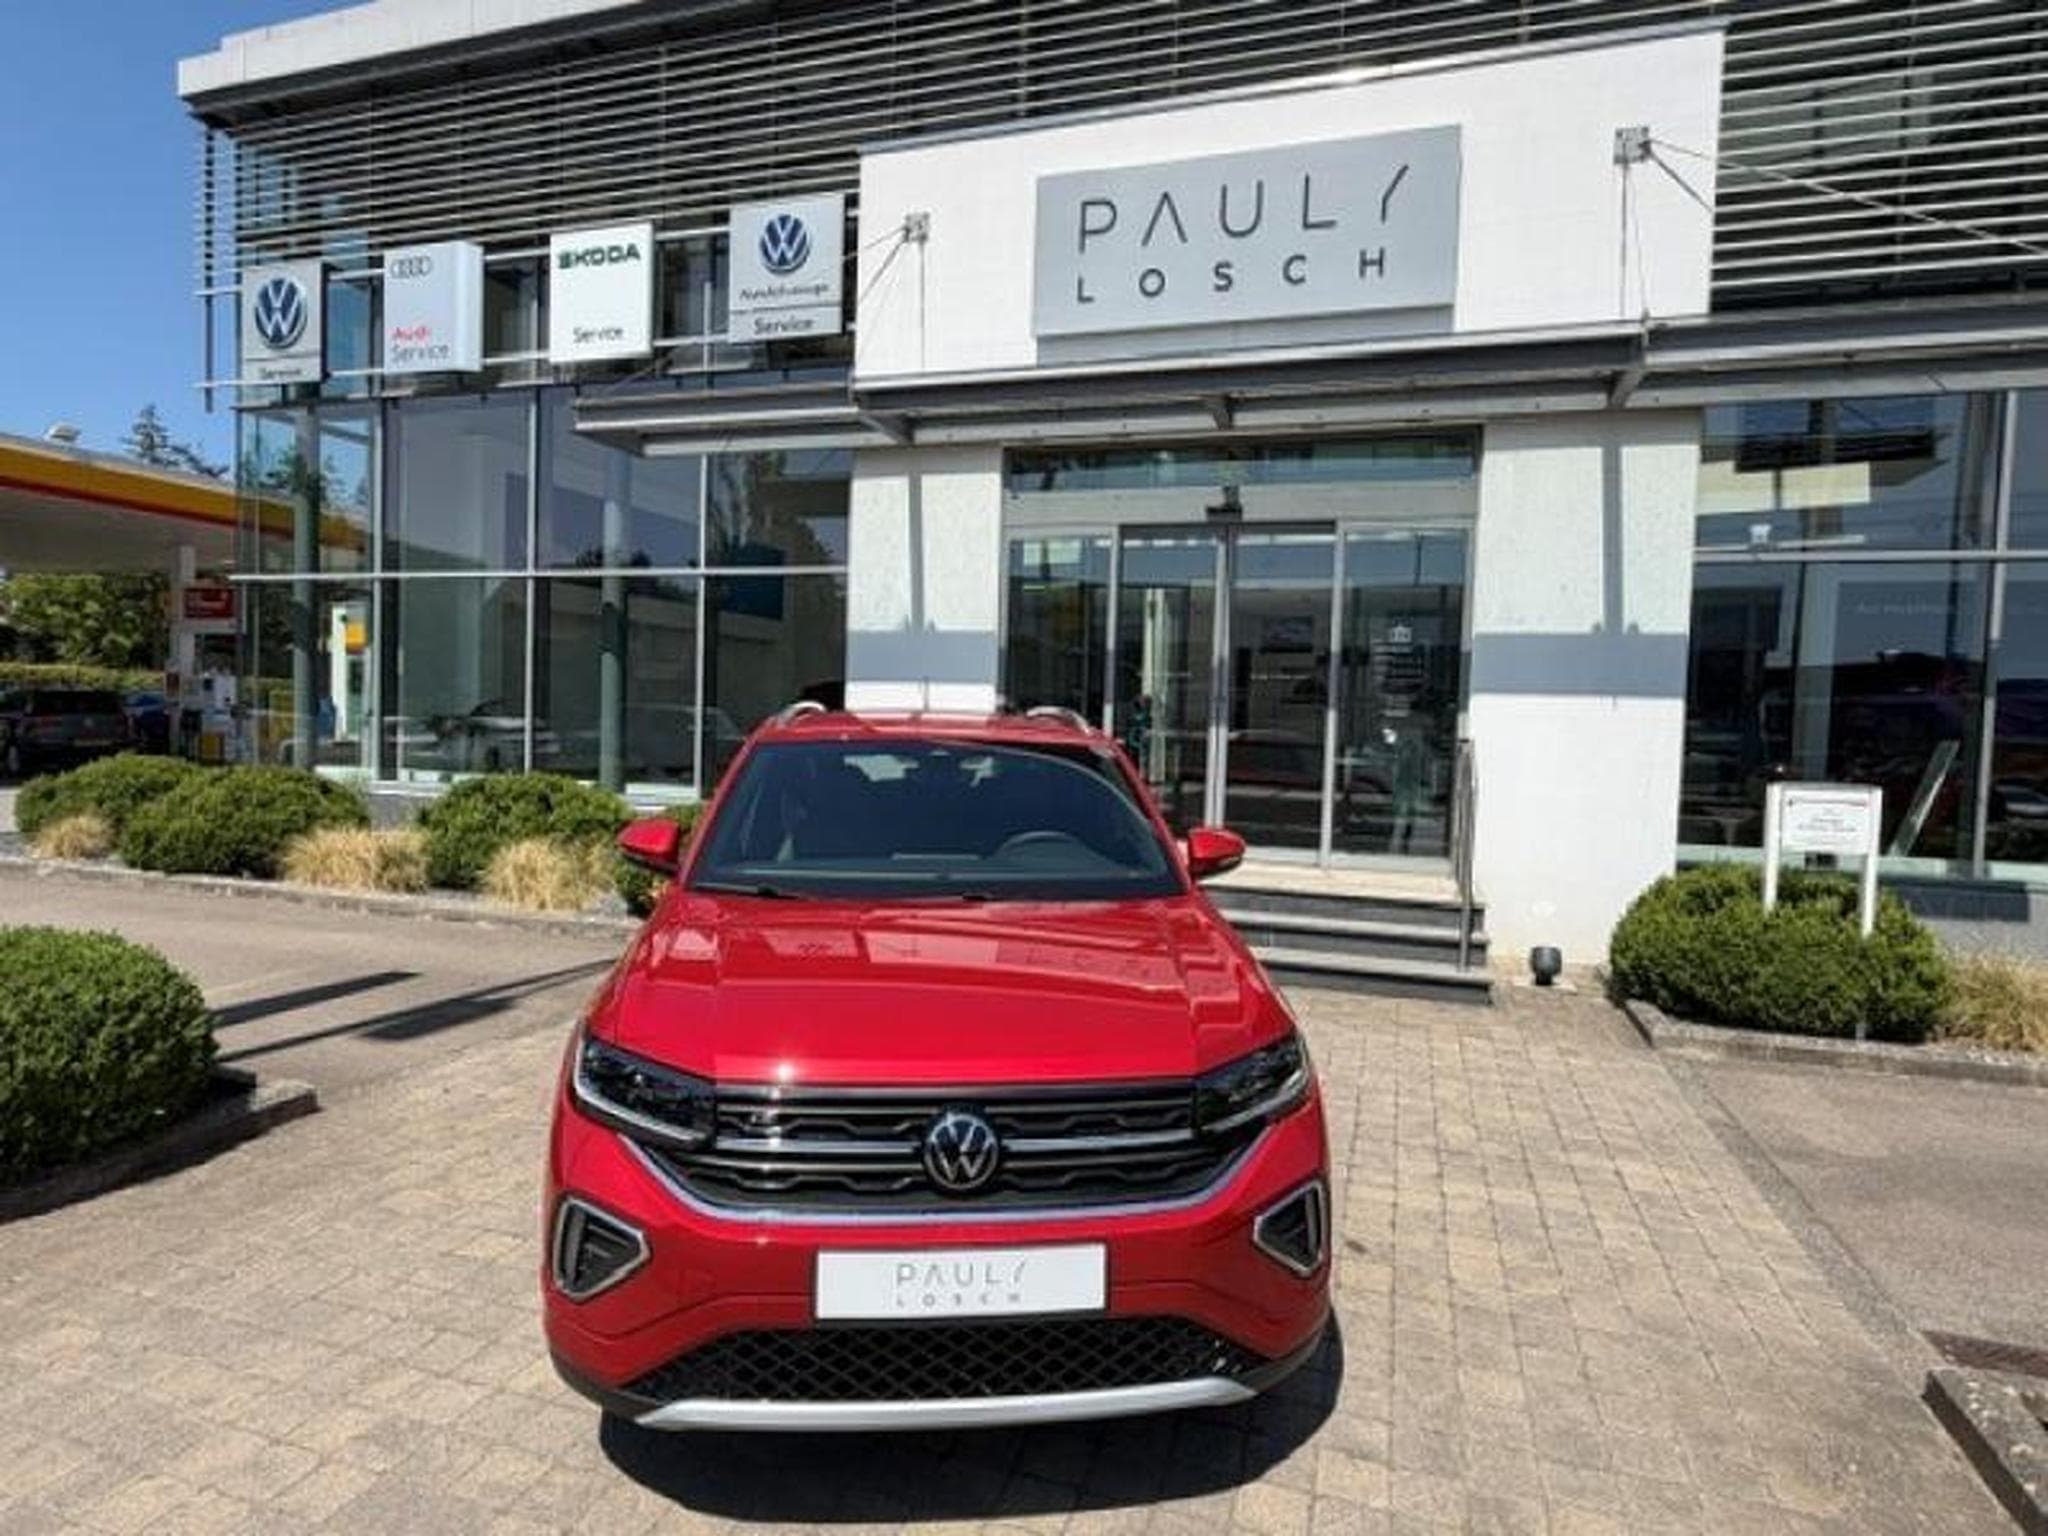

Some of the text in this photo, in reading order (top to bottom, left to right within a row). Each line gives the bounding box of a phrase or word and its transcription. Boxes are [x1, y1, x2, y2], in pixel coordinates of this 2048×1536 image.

[1079, 163, 1410, 254] PAULY
[1077, 247, 1386, 304] LOSCH
[753, 315, 816, 335] Service
[389, 344, 450, 363] Service
[896, 1260, 1028, 1287] PAULY
